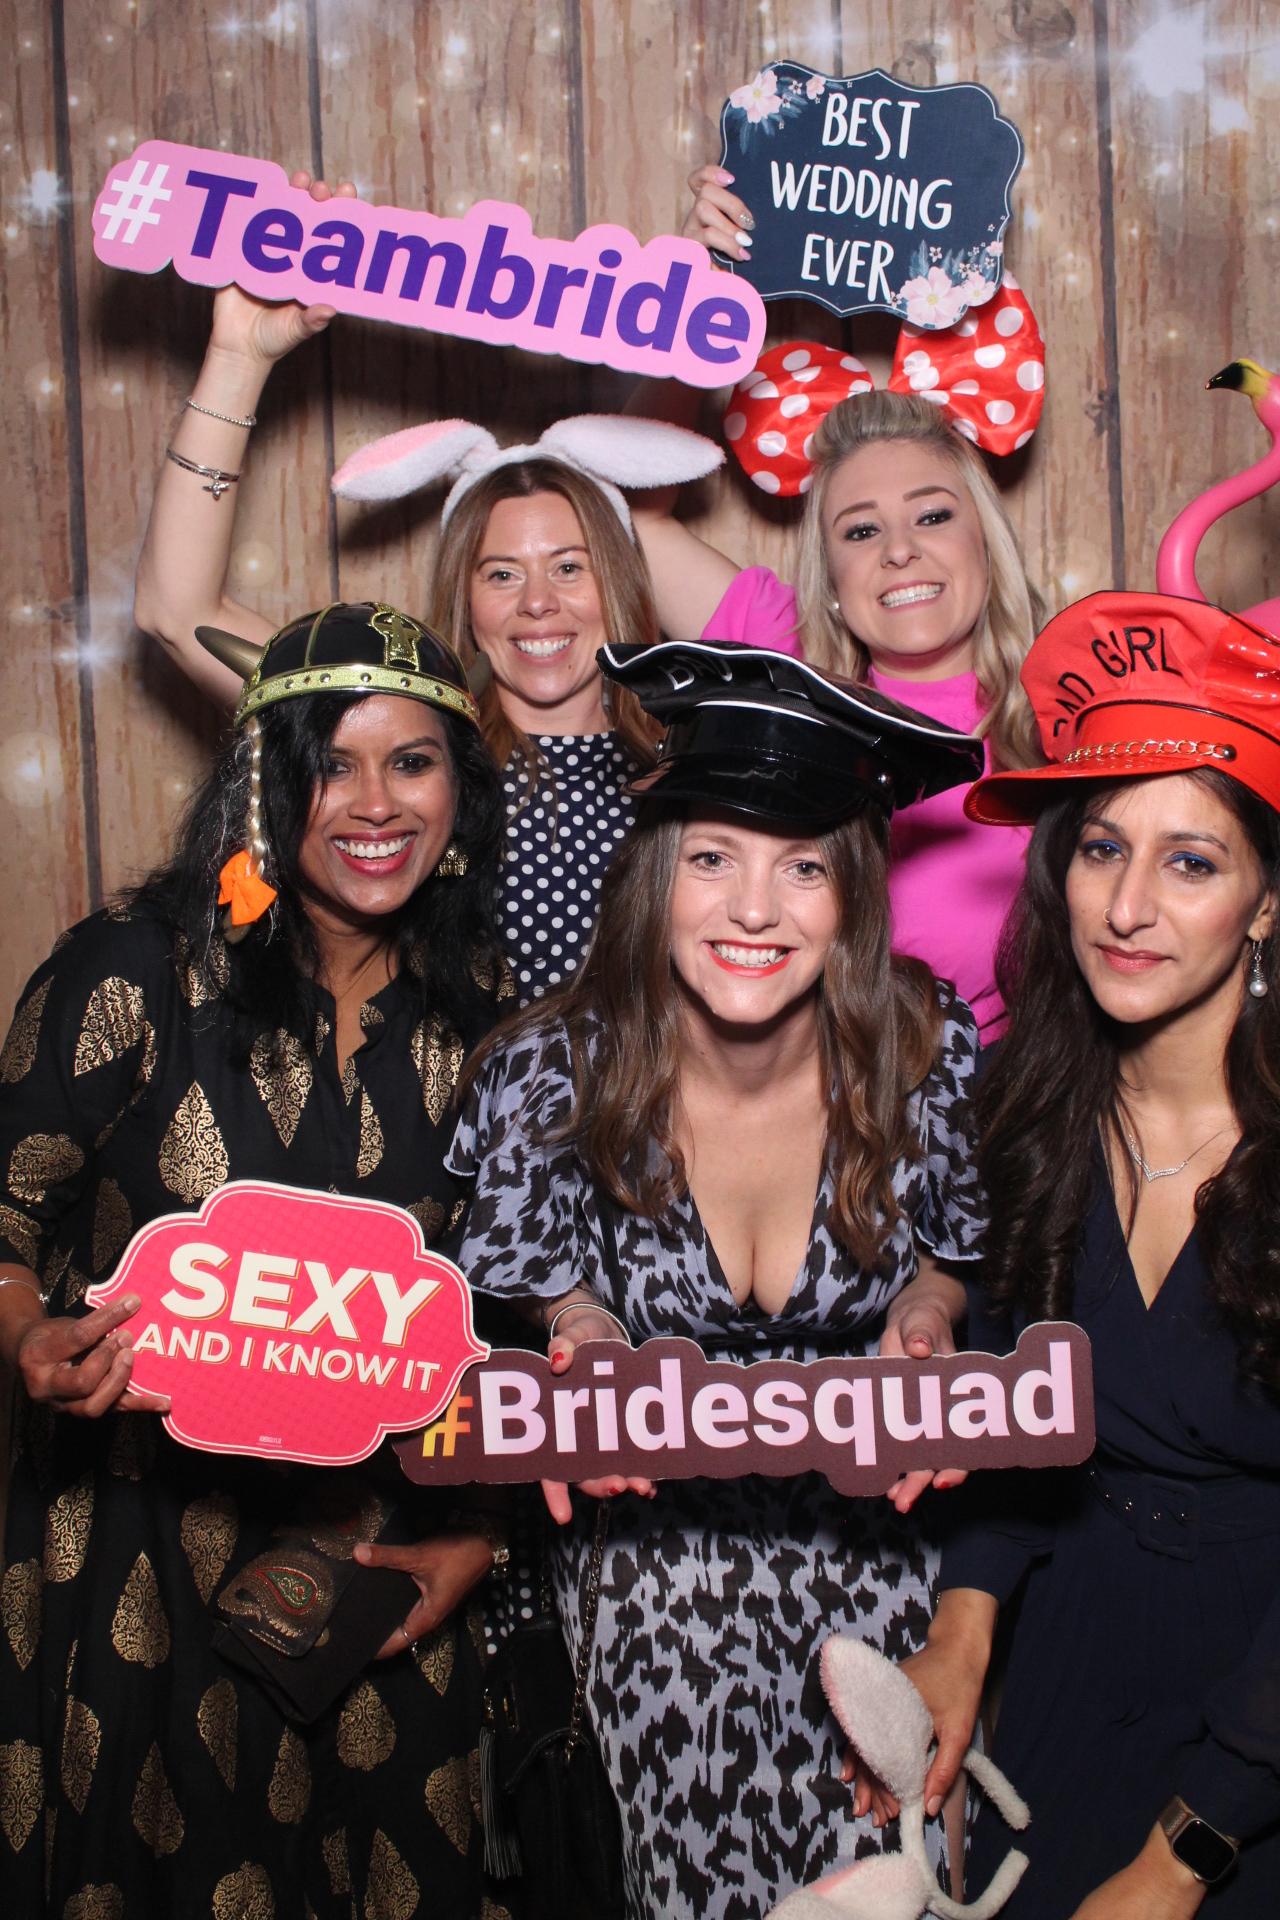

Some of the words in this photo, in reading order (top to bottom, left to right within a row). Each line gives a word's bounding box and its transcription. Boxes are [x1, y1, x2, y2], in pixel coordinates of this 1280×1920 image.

[822, 93, 921, 161] BEST
[770, 160, 953, 230] WEDDING
[98, 158, 751, 365] #Teambride
[800, 233, 895, 303] EVER
[1090, 625, 1184, 679] GIRL
[159, 1241, 444, 1348] SEXY
[131, 1322, 231, 1365] AND
[239, 1336, 255, 1369] I
[261, 1339, 399, 1388] KNOW
[401, 1359, 443, 1393] IT
[421, 1340, 1077, 1467] #Bridesquad
